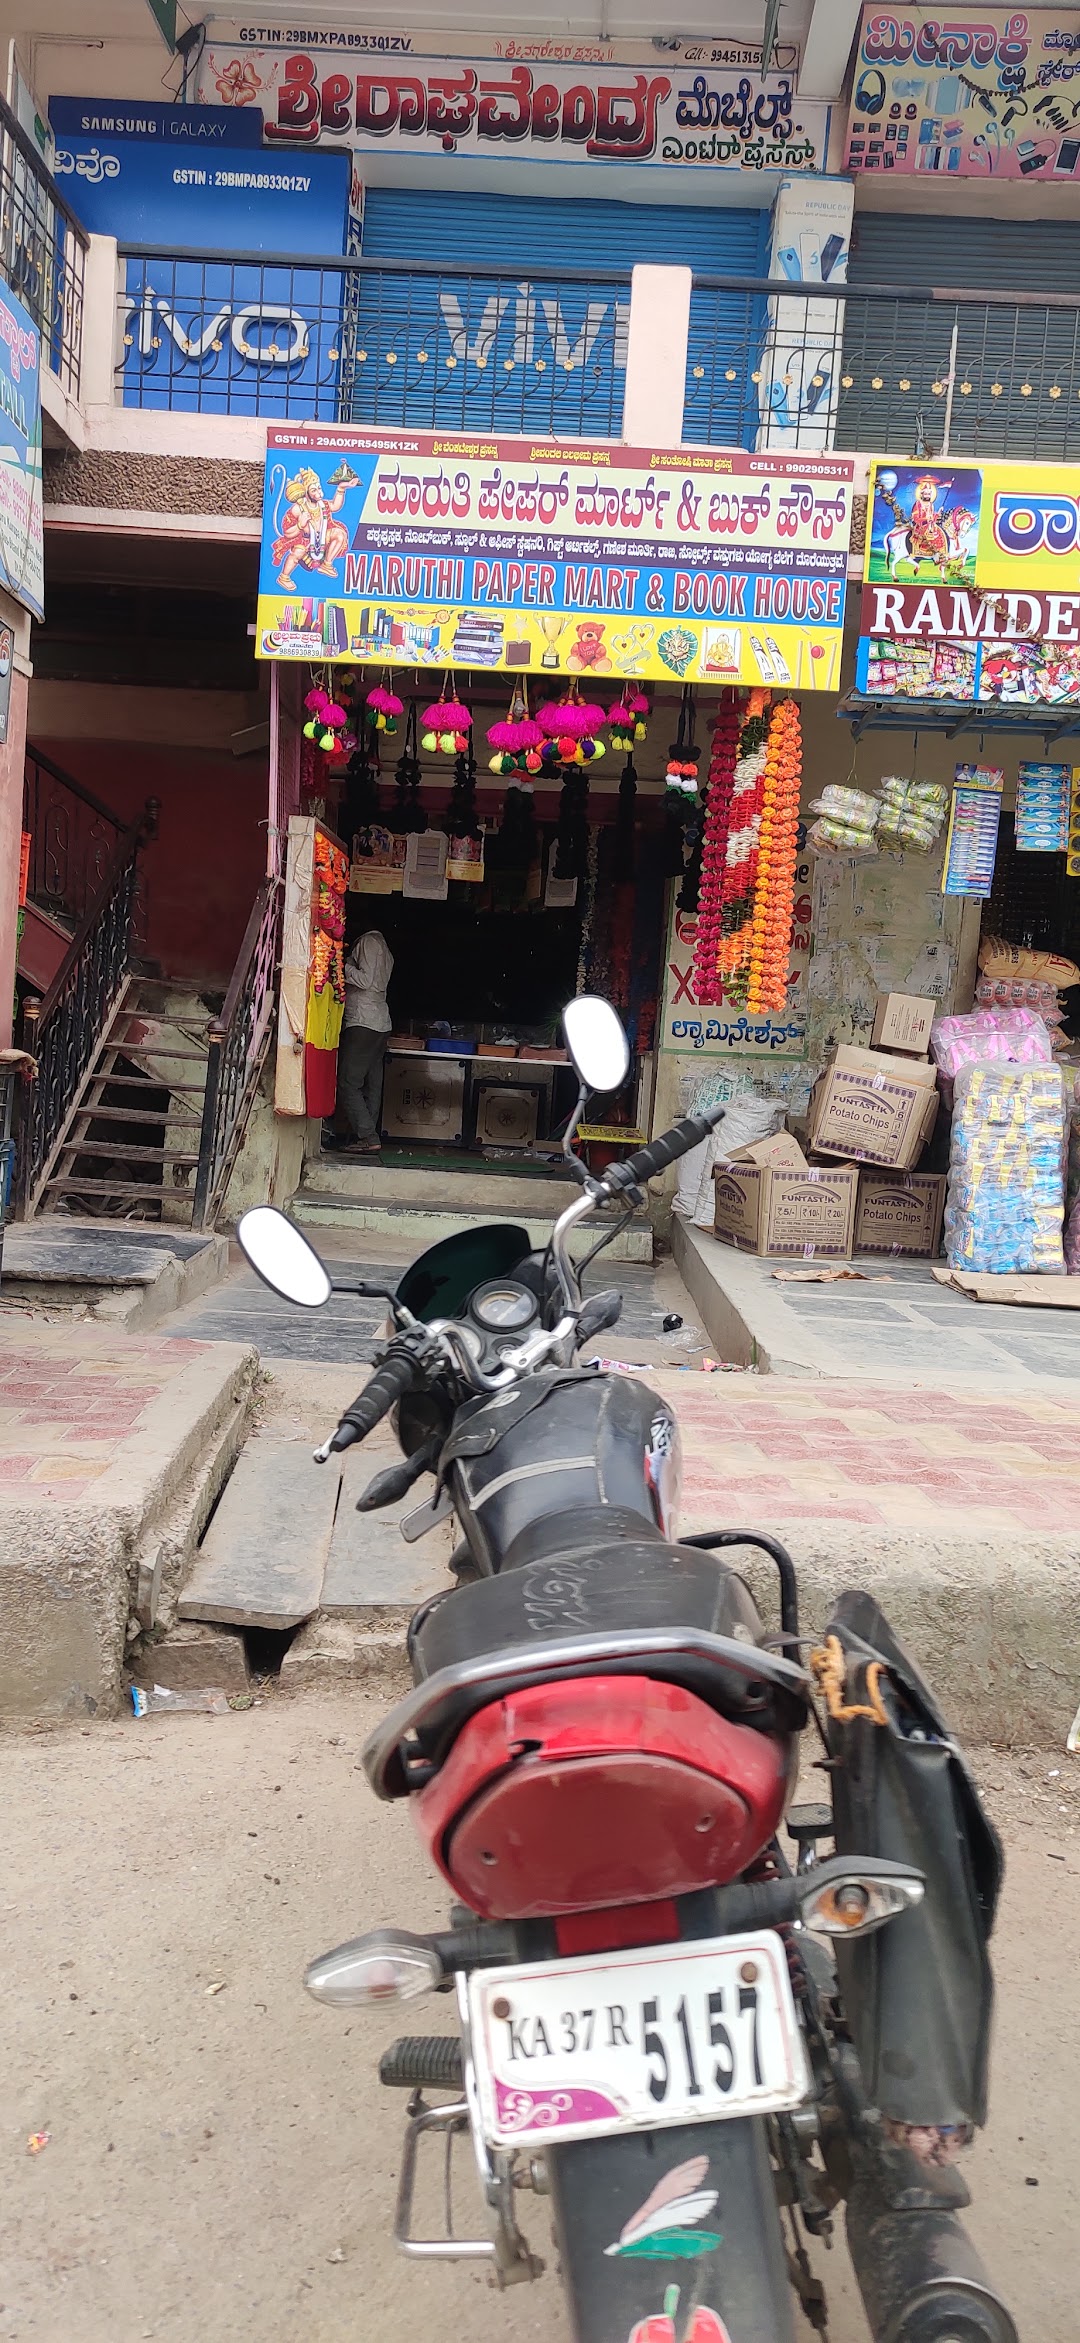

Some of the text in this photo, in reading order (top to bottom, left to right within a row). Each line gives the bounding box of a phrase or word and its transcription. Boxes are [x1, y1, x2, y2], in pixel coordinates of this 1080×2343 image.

[81, 116, 227, 138] SAMSUNG GALAXY
[173, 169, 206, 185] GSTIN
[214, 171, 311, 192] 29BMPA8933Q1ZV
[124, 285, 310, 364] ivo
[275, 435, 308, 446] GSTIN
[750, 462, 777, 472] CELL
[786, 464, 849, 476] 9902905311
[375, 461, 471, 518] ಮಾರುತಿ
[477, 466, 569, 525] ಪೇಪರ್
[676, 479, 702, 532] &
[708, 483, 771, 535] ಬುಕ್
[776, 484, 846, 541] ಹೌಸ್
[479, 533, 488, 547] &
[344, 554, 842, 622] MARUTHI PAPER MART & BOOK HOUSE
[829, 1105, 890, 1129] Potato Chips
[863, 1208, 922, 1224] Potato Chips
[506, 1984, 766, 2104] KA 37 R 5157
